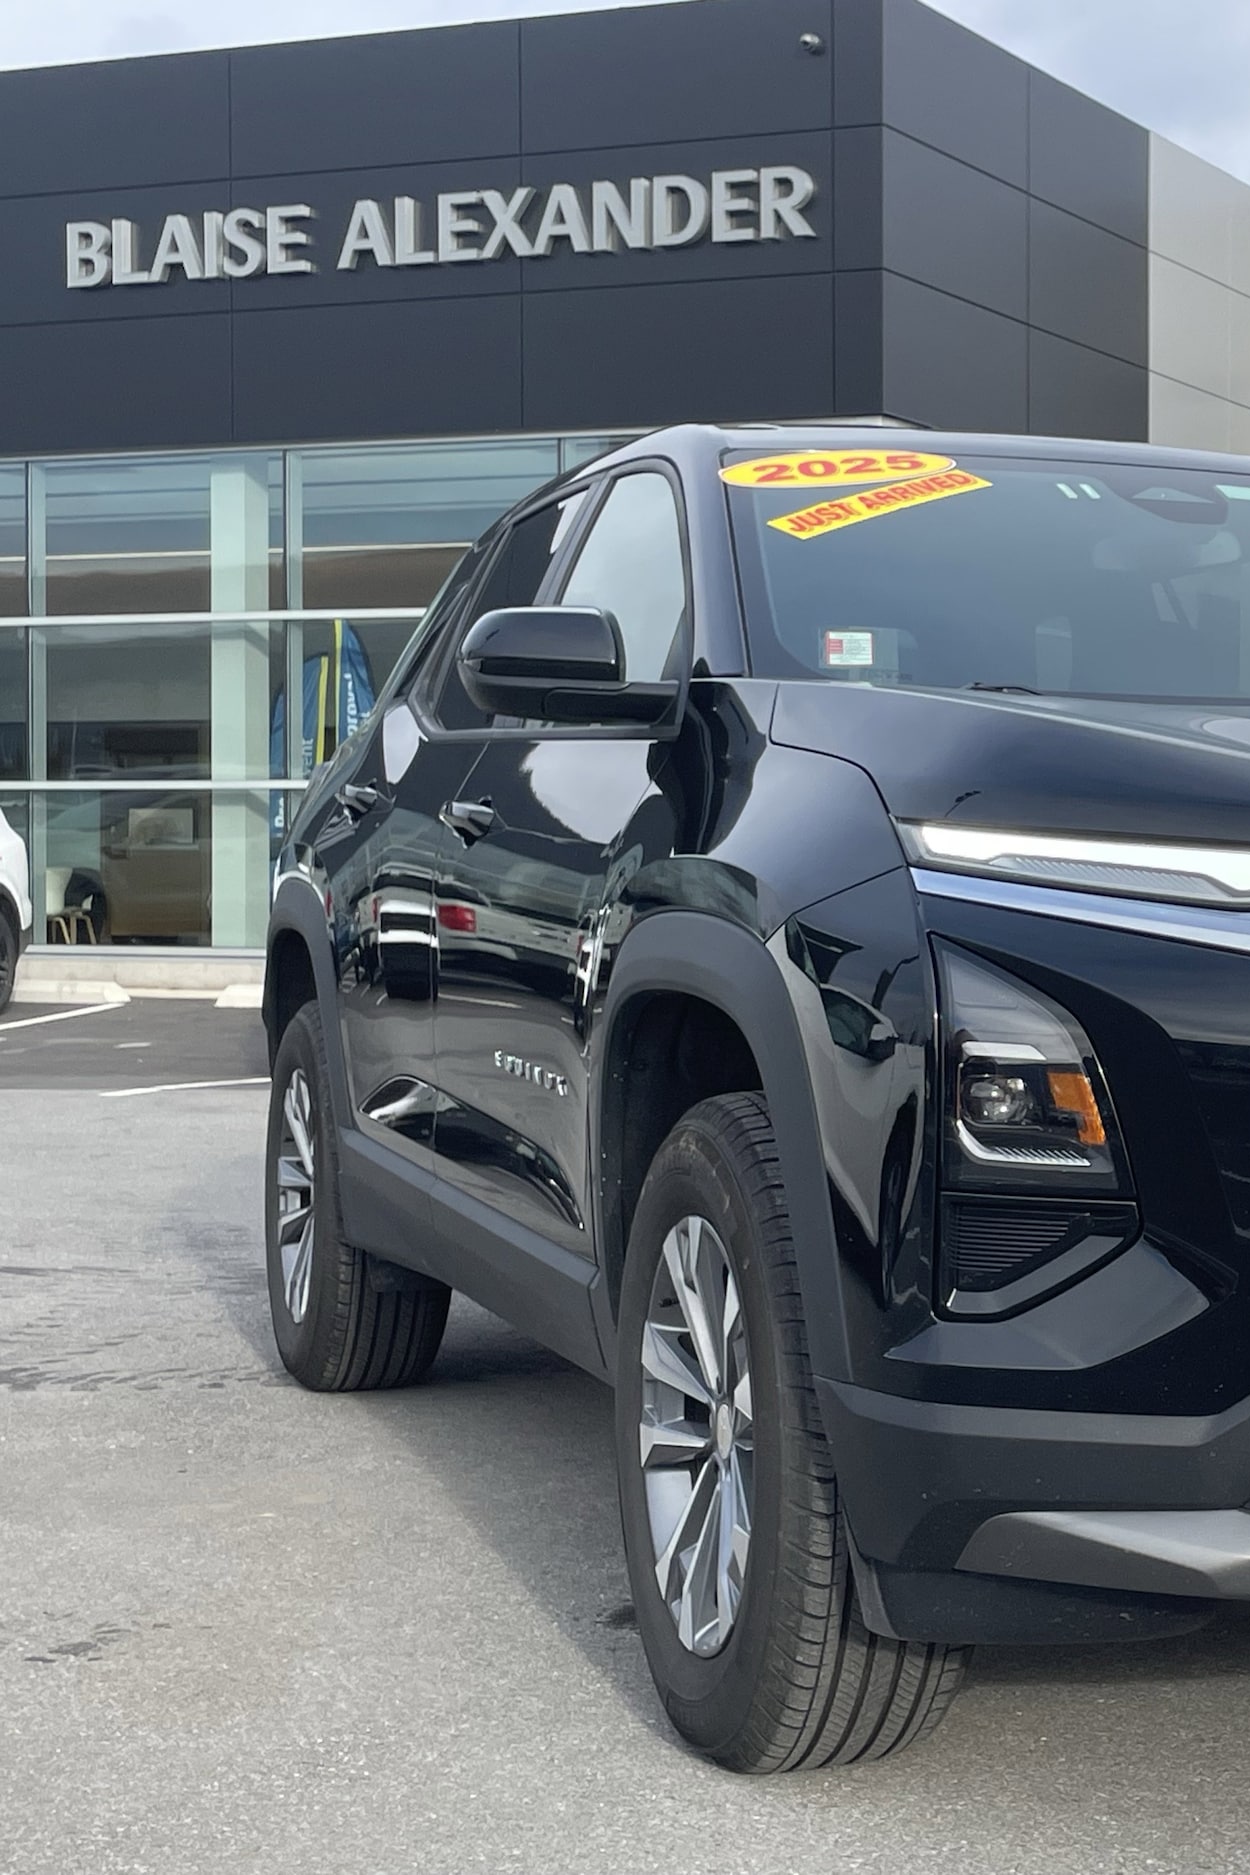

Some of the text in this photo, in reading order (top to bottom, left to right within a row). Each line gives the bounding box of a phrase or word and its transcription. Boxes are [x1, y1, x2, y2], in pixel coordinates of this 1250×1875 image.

[66, 165, 817, 289] BLAISE ALEXANDER
[753, 454, 926, 484] 2025
[787, 473, 978, 533] JUST ARRIVED
